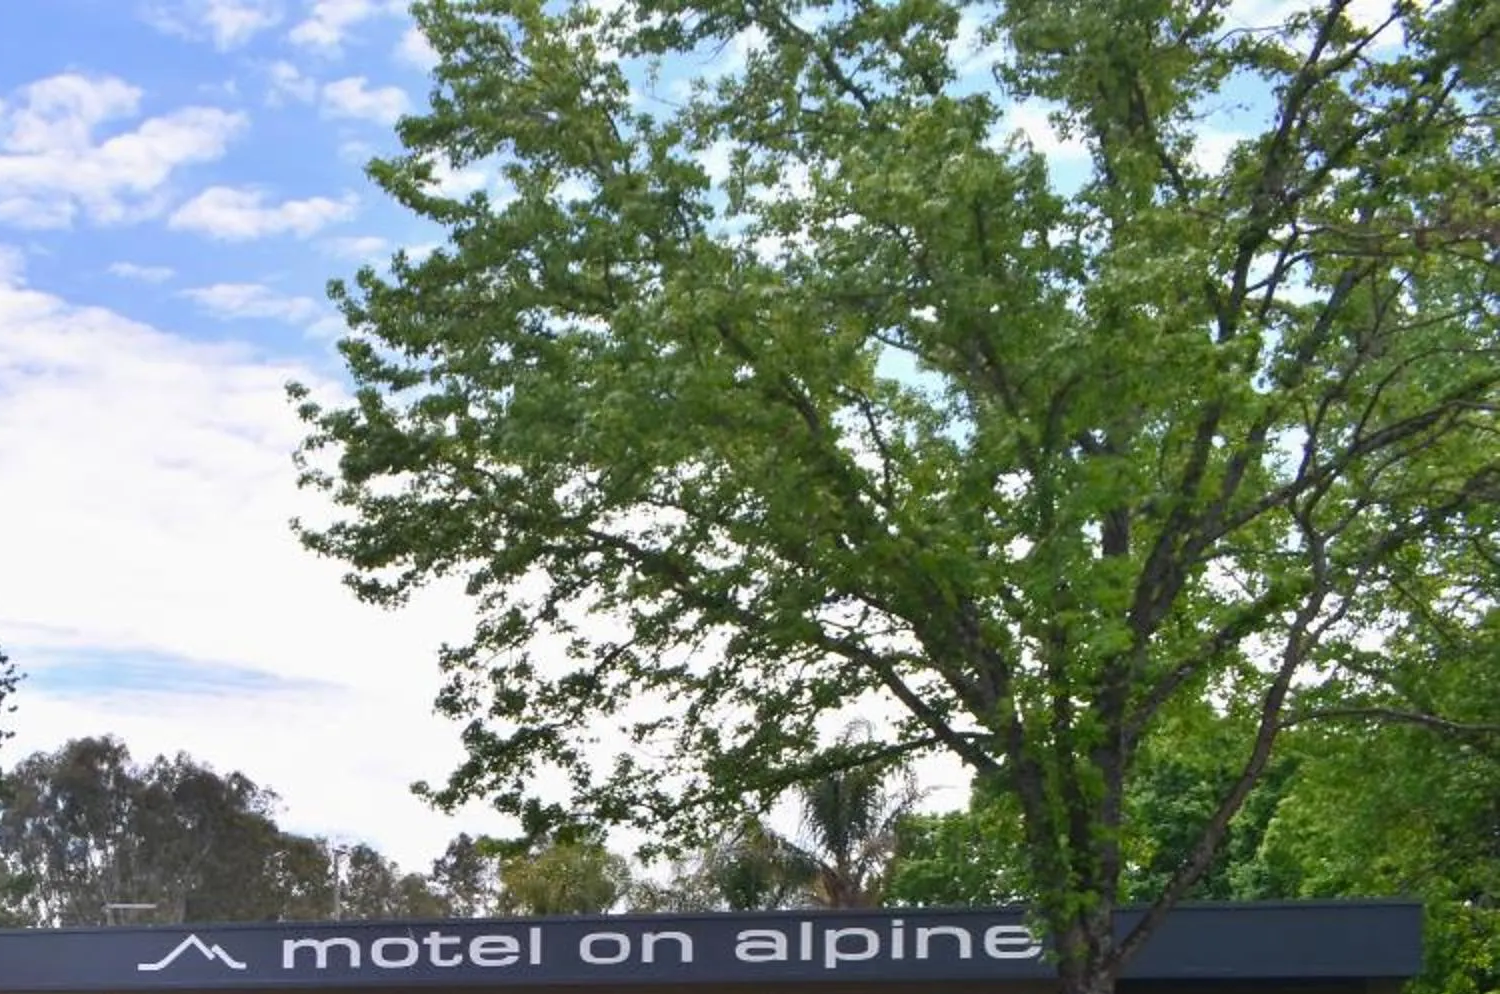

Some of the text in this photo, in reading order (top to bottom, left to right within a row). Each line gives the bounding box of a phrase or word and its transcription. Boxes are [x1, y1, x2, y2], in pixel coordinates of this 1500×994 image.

[283, 920, 1043, 969] motel on alpine
